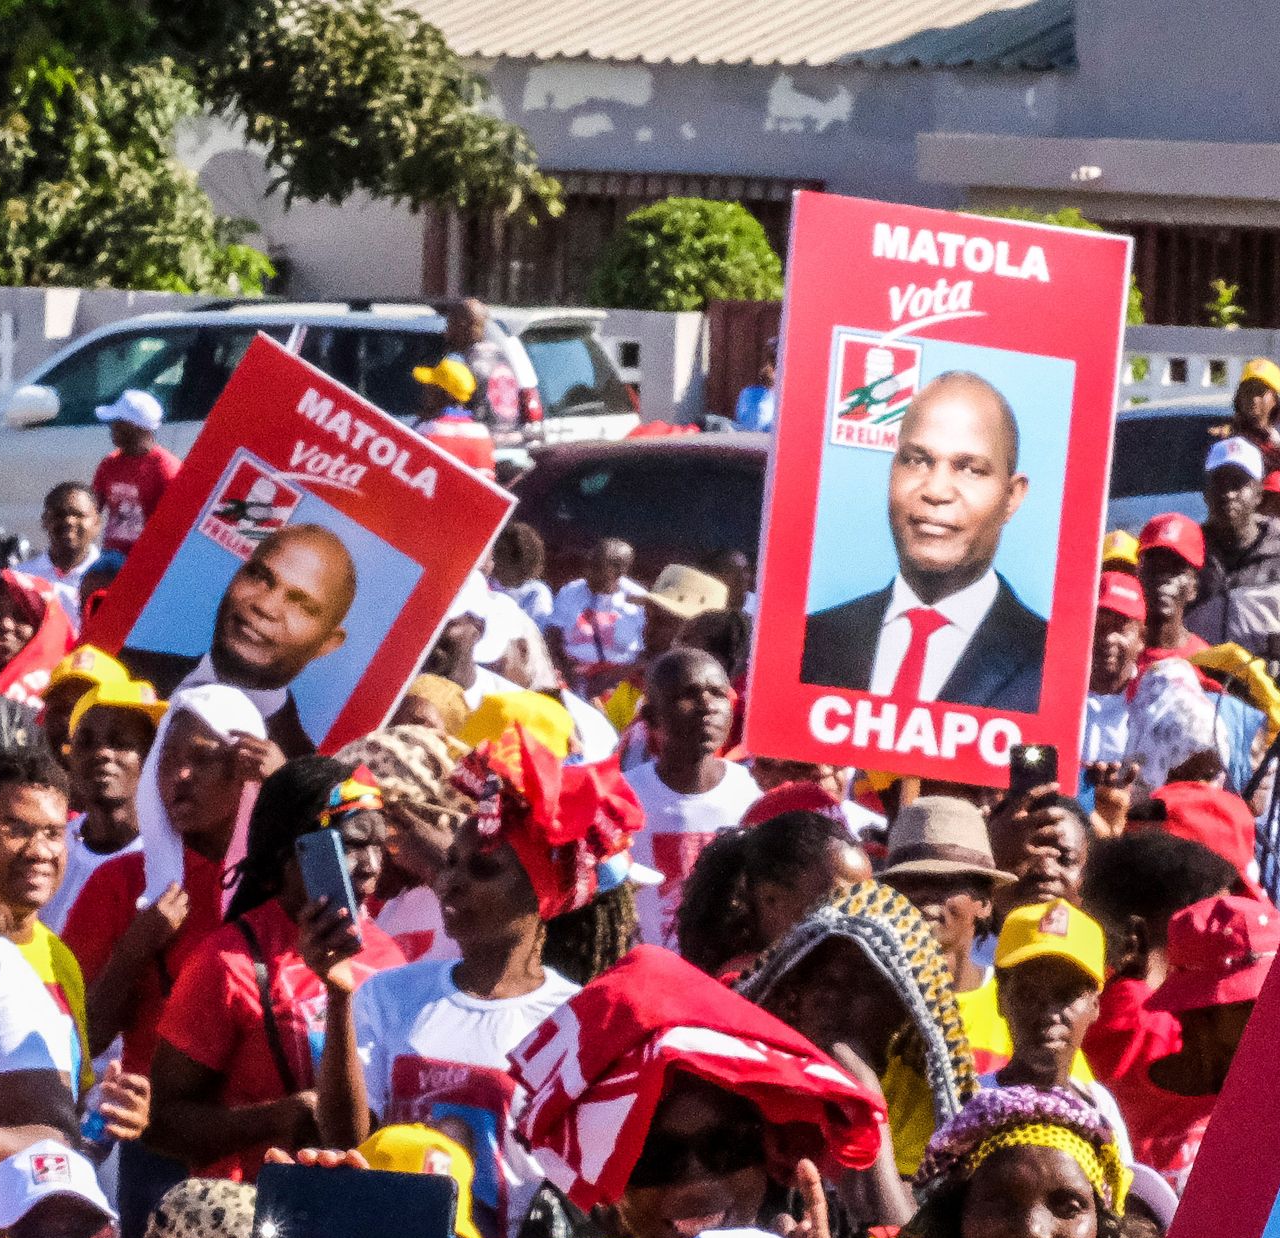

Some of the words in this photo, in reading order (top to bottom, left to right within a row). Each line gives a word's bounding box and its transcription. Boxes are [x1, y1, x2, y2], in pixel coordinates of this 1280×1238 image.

[872, 222, 1051, 283] MATOLA
[888, 277, 974, 322] Vota
[288, 438, 370, 487] Vota
[295, 386, 439, 499] MATOLA
[836, 423, 898, 447] FRELIM
[808, 694, 1023, 767] CHAPO
